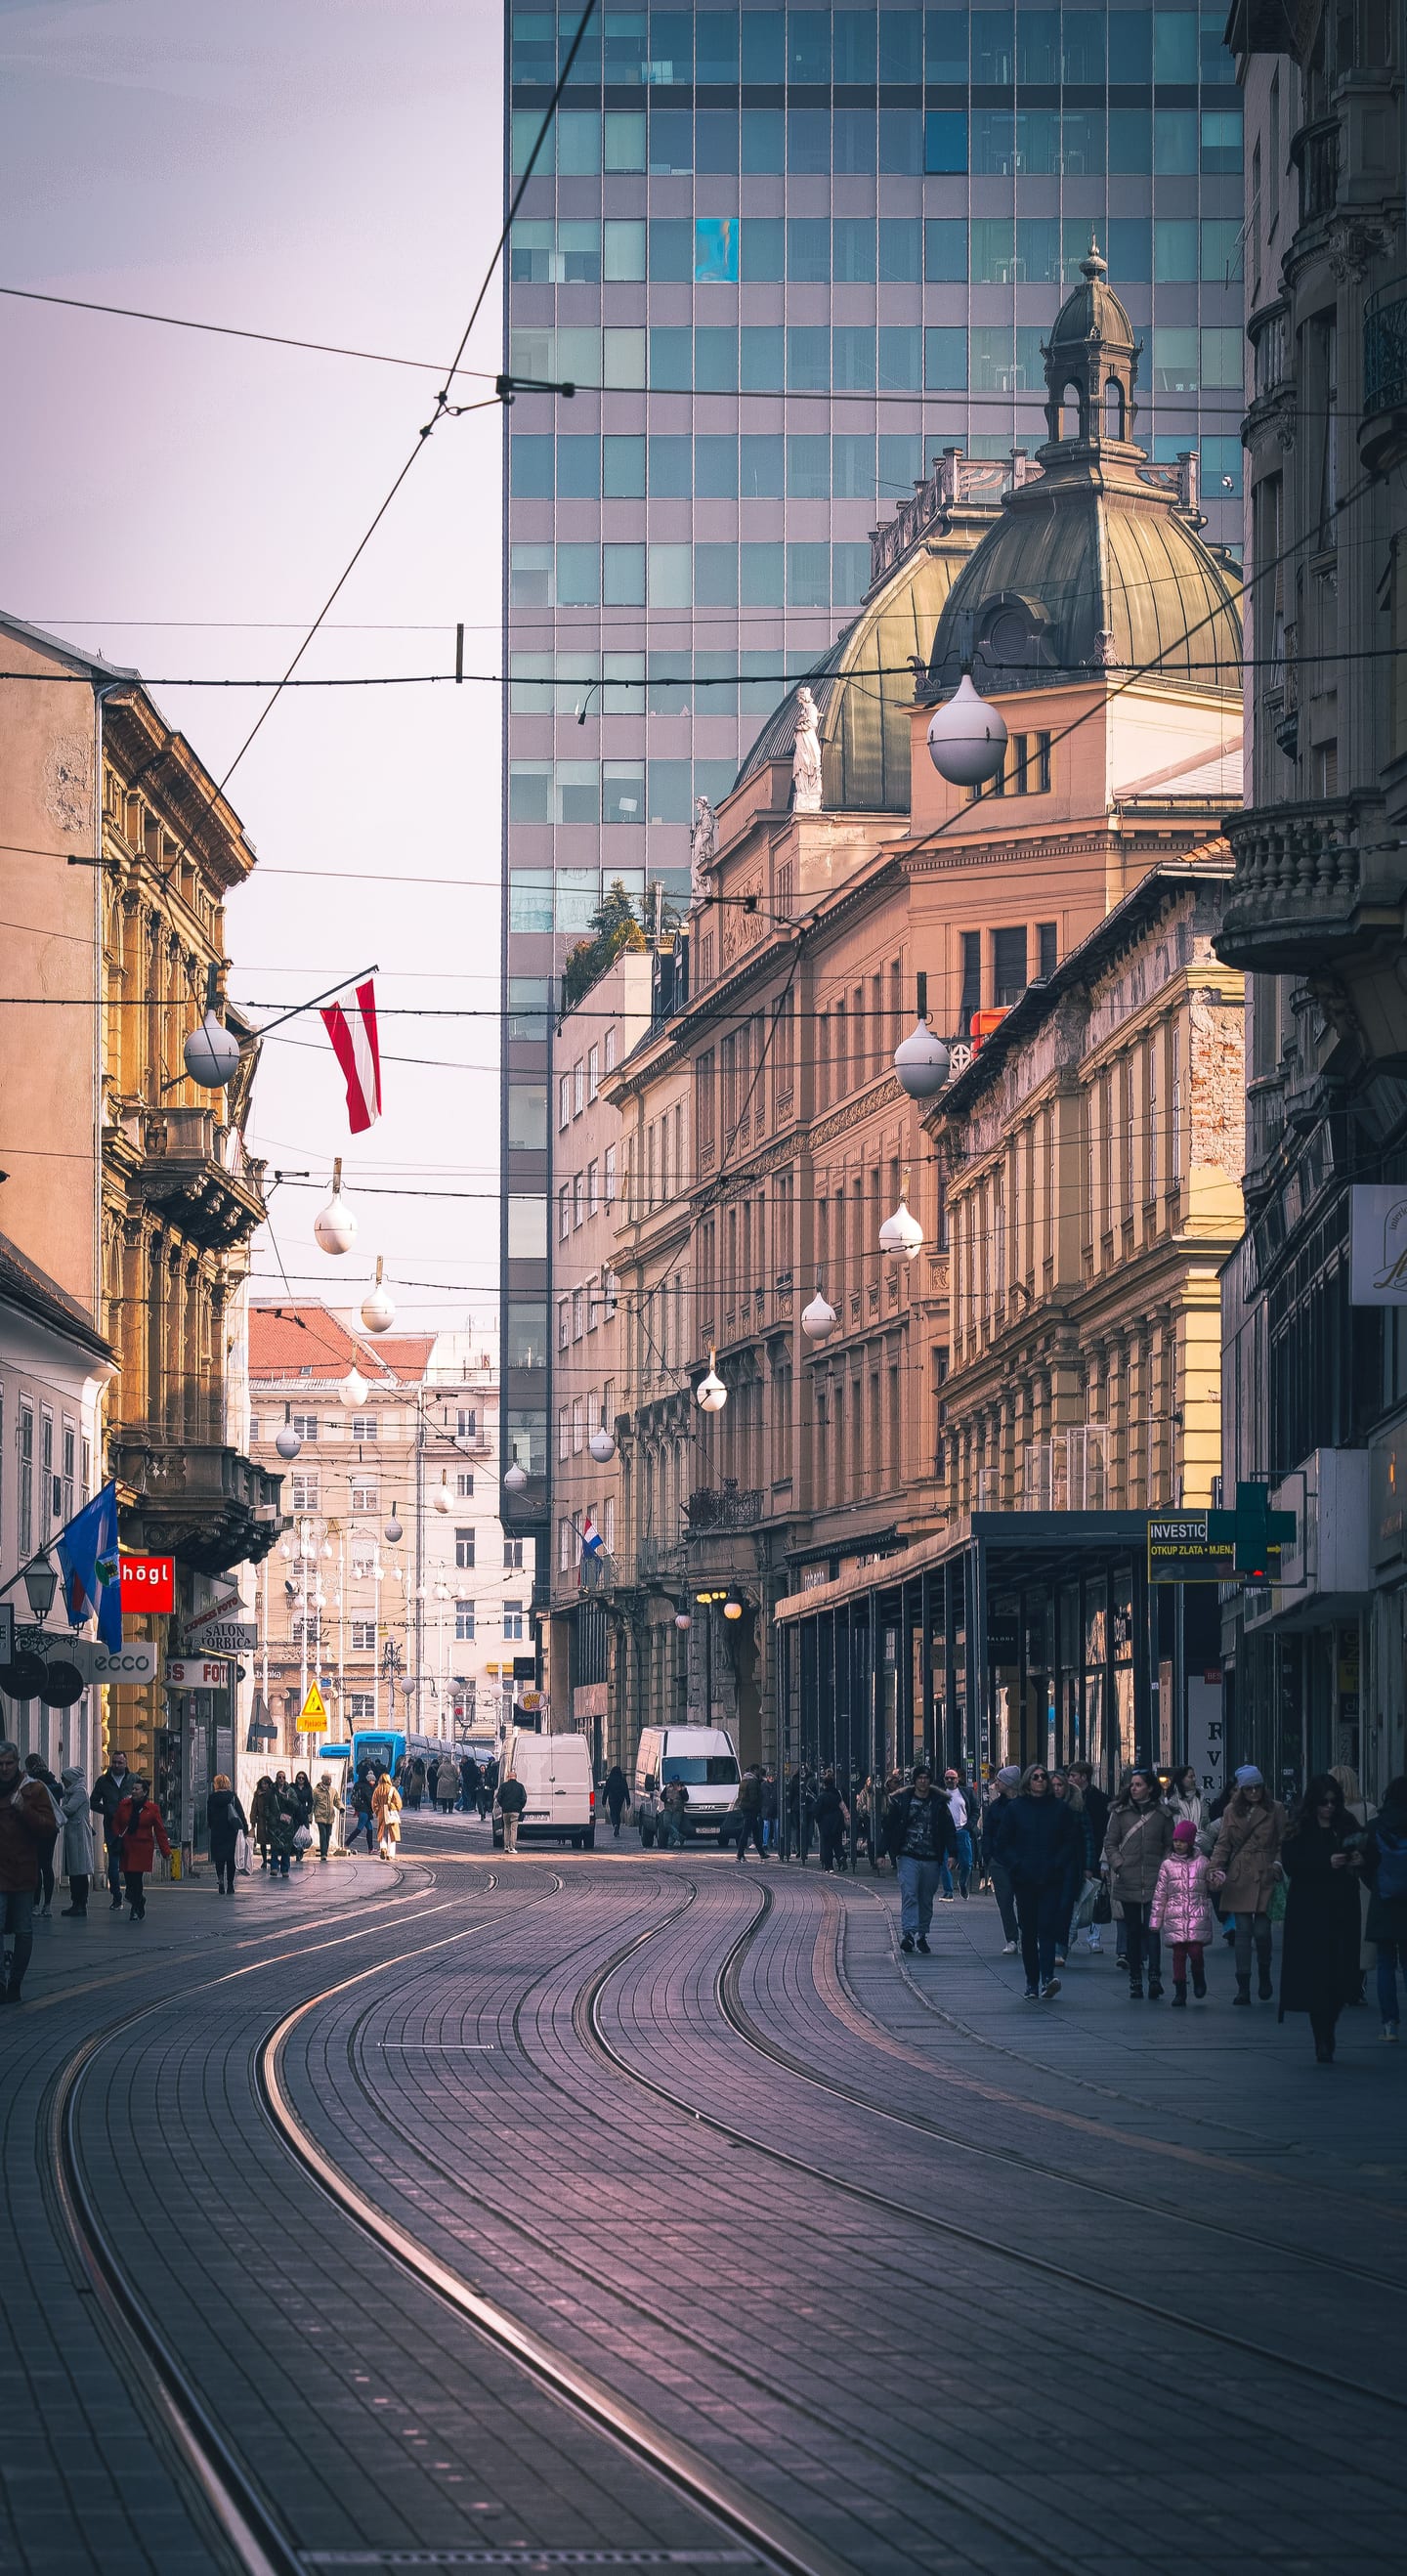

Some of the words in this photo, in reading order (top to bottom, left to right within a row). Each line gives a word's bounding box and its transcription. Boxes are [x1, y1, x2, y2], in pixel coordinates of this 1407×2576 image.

[1150, 1546, 1178, 1556] OTKUP
[1179, 1545, 1204, 1555] ZLATA
[218, 1596, 238, 1614] FOTO
[205, 1624, 245, 1638] SALON
[94, 1654, 149, 1671] ecco
[203, 1663, 229, 1682] FOT
